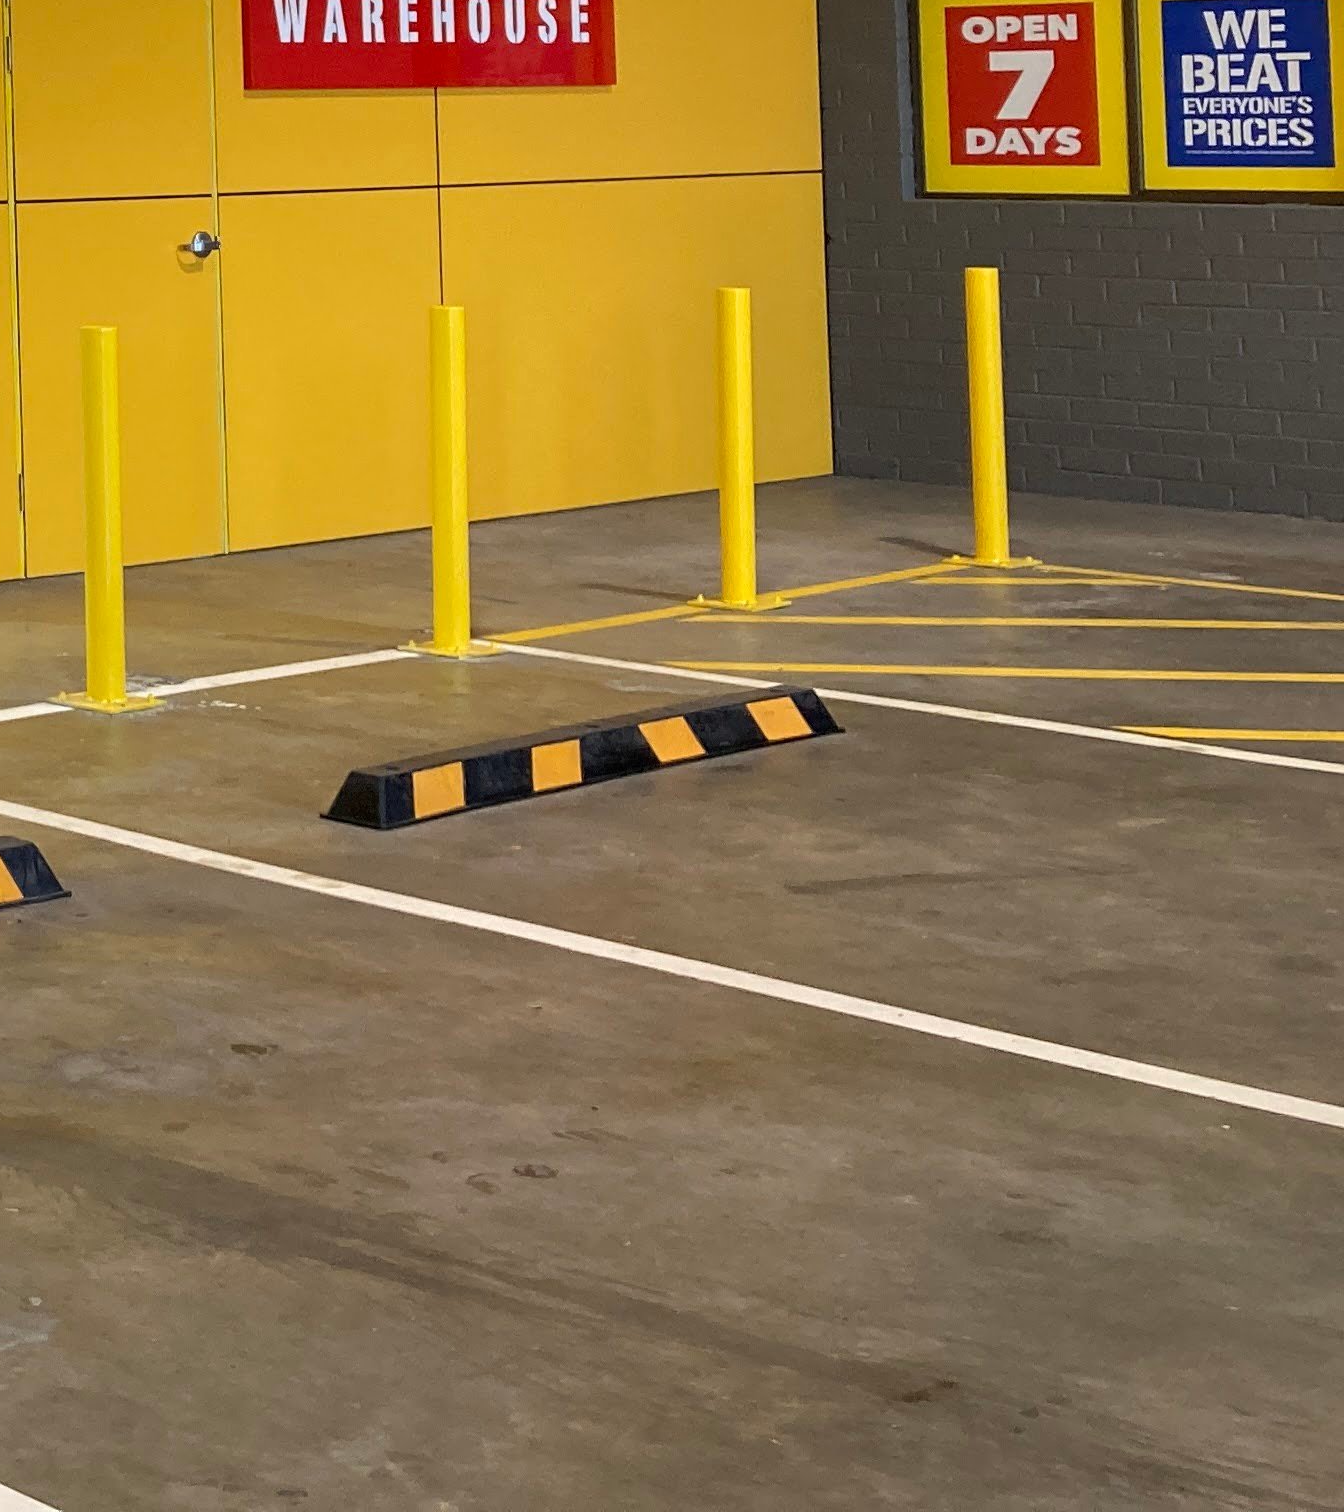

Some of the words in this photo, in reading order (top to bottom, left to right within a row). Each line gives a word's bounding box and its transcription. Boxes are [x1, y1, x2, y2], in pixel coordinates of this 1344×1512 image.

[961, 12, 1078, 45] OPEN
[1202, 8, 1287, 51] WE
[988, 49, 1055, 121] 7
[1180, 51, 1312, 94] BEAT
[1182, 95, 1313, 115] EVERYONE'S
[965, 126, 1082, 157] DAYS
[1183, 117, 1315, 147] PRICES
